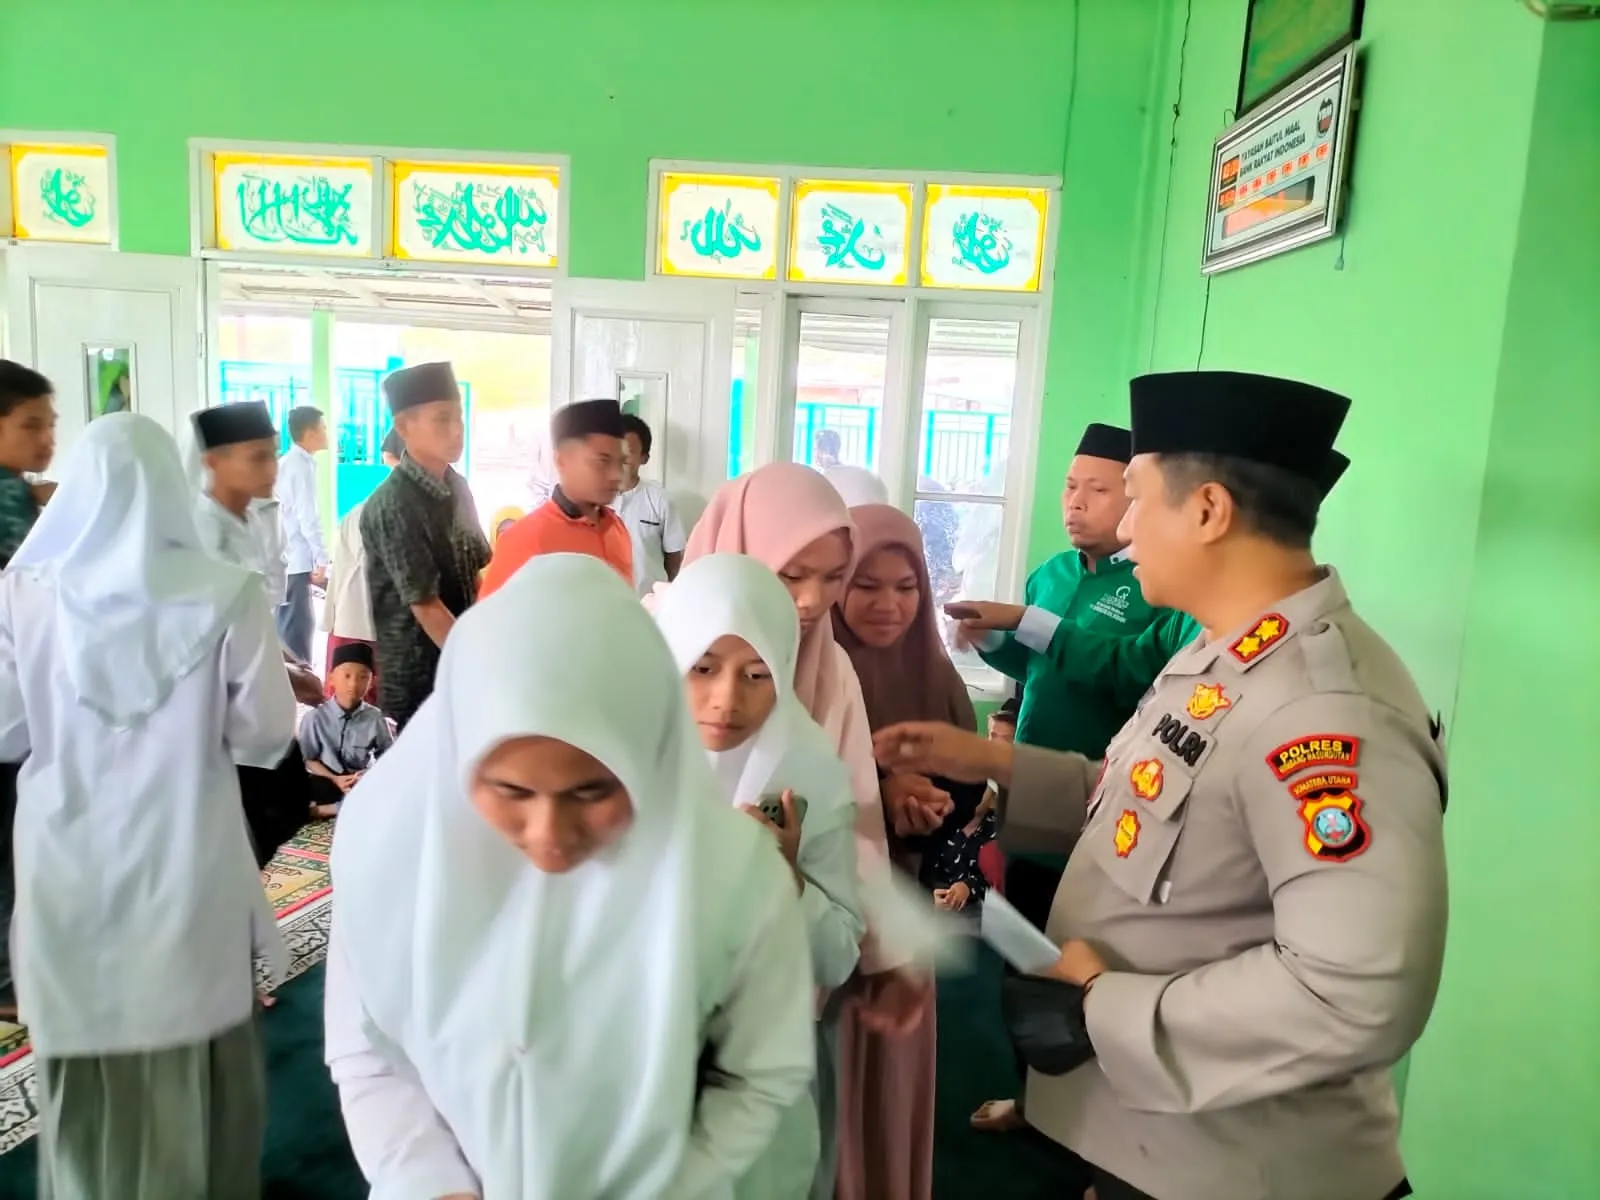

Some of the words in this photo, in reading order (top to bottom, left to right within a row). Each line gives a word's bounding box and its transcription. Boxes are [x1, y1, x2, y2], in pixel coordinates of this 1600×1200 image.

[1254, 150, 1274, 169] RAKYAT
[1274, 132, 1306, 158] INDONESIA
[1265, 130, 1283, 148] BAITUL
[1152, 713, 1207, 767] POLRI
[1279, 739, 1343, 764] POLRES
